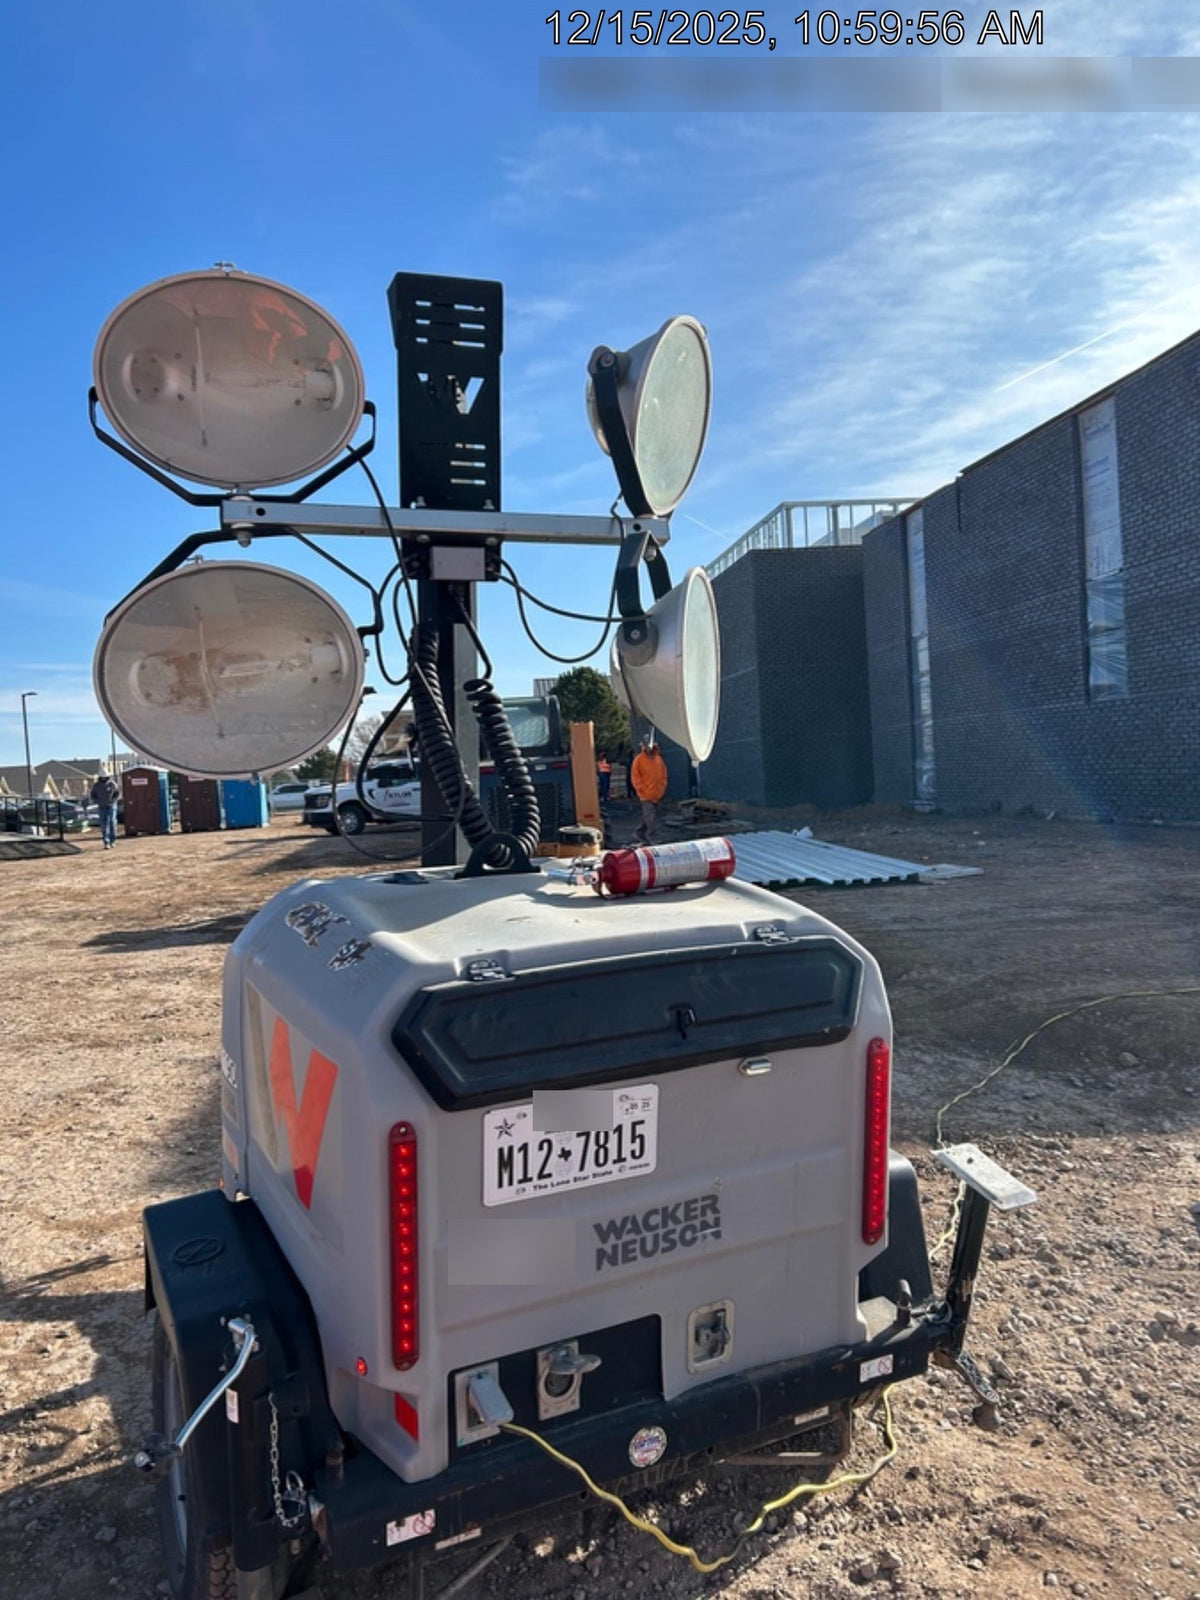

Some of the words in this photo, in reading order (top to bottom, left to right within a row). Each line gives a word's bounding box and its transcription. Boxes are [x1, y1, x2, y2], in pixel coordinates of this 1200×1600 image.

[497, 1138, 552, 1189] M12
[576, 1119, 646, 1172] 7815
[533, 1182, 548, 1191] The
[551, 1179, 571, 1188] Lone
[573, 1174, 590, 1183] Star
[592, 1170, 613, 1179] State
[593, 1194, 721, 1244] WACKER
[595, 1217, 722, 1271] NEUSON
